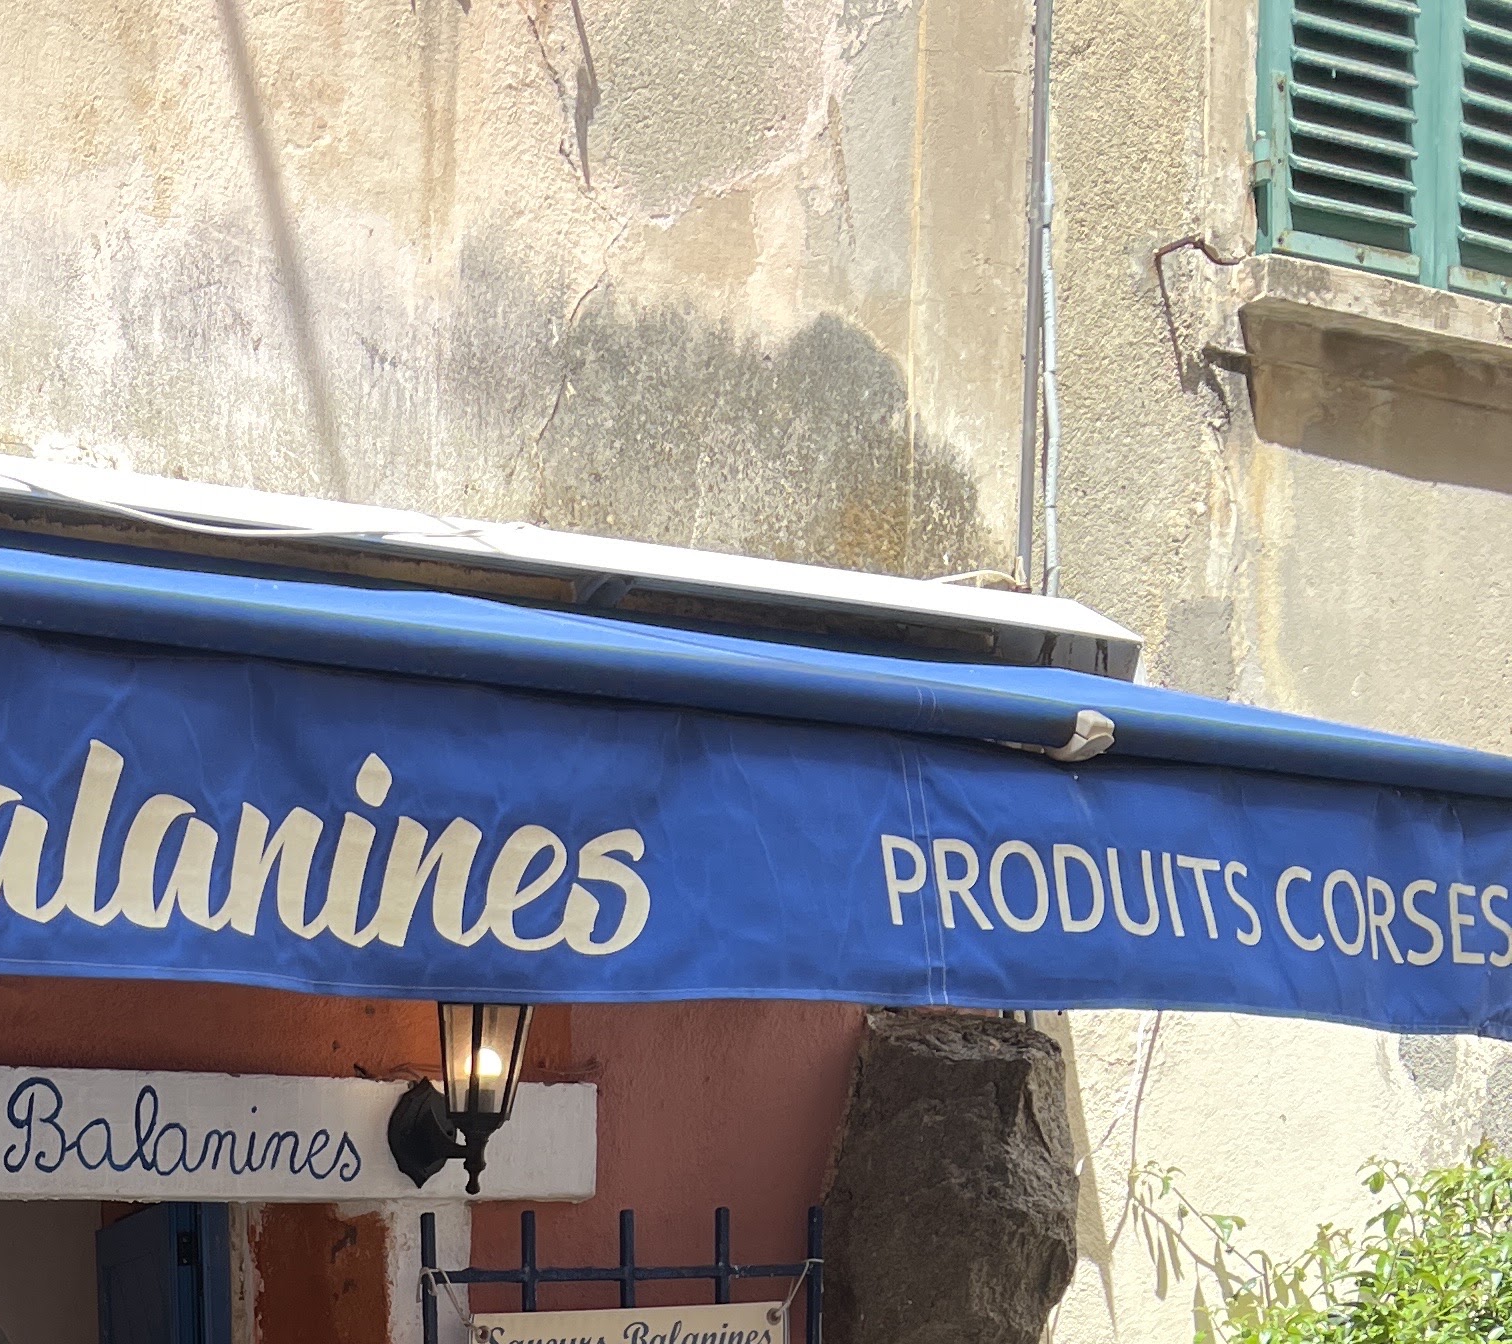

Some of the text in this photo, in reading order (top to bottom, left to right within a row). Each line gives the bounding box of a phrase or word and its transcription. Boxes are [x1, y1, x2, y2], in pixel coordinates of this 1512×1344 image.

[880, 833, 1512, 968] PRODUITS CORSES
[3, 1076, 363, 1182] Balanines
